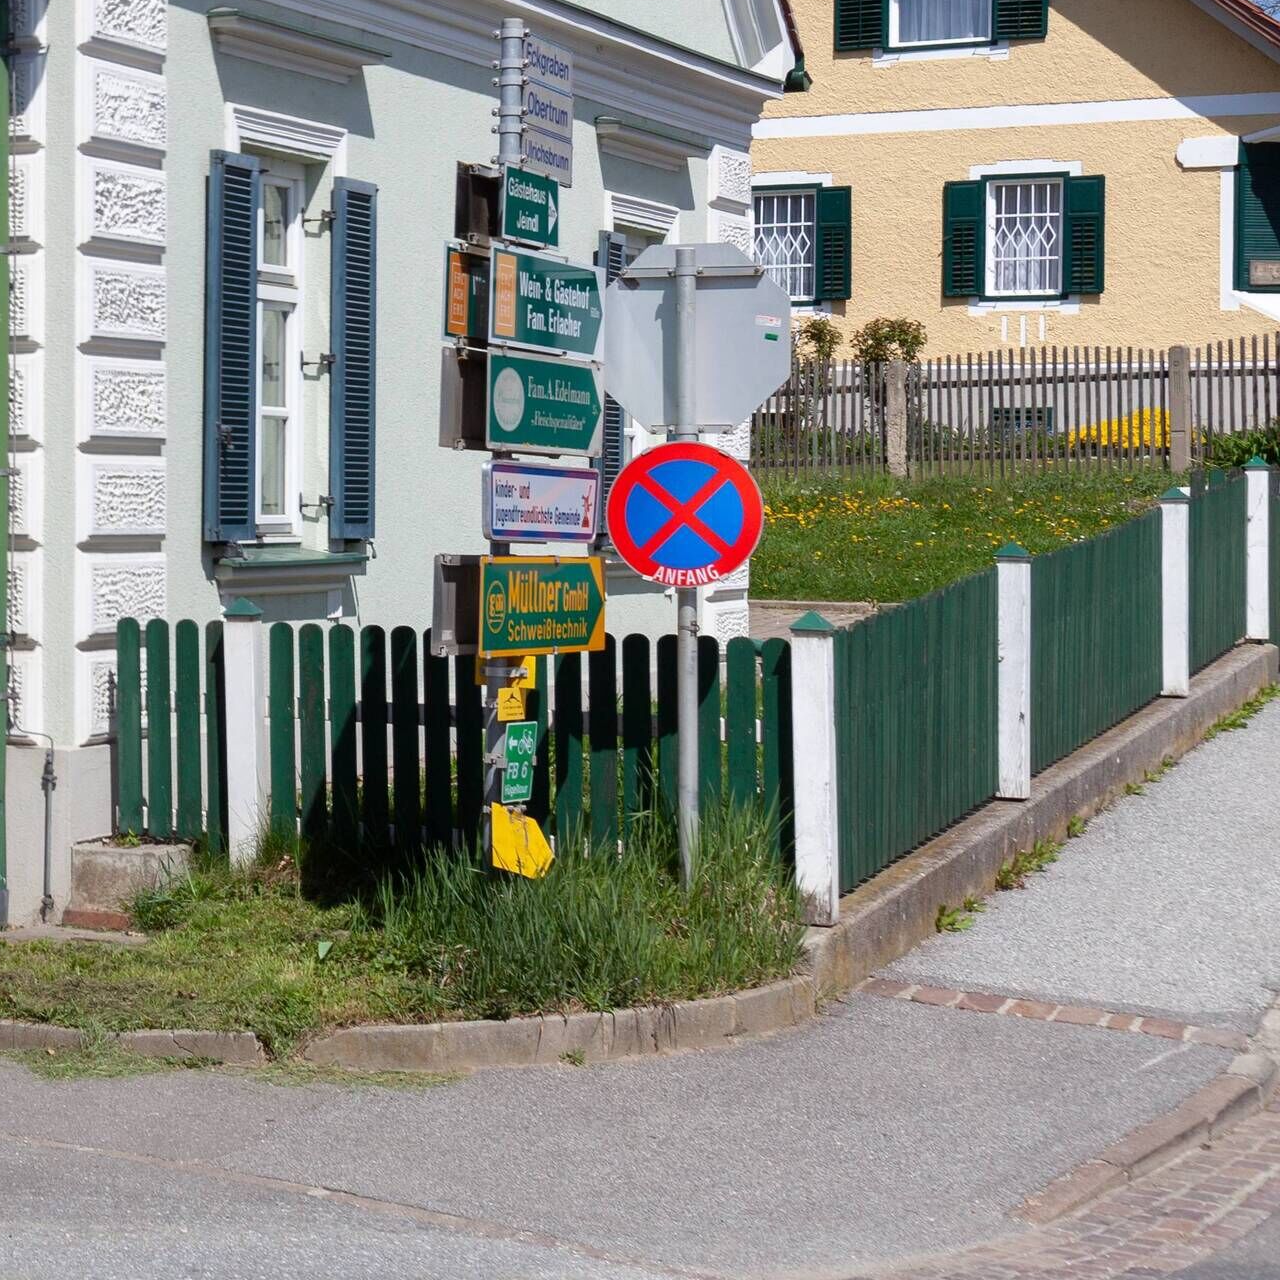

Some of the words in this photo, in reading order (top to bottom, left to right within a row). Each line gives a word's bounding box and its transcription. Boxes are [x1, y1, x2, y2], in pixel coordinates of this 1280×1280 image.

[527, 42, 569, 81] Eckgraben
[527, 91, 568, 128] Obertrum
[508, 177, 546, 205] Gästehaus
[517, 210, 539, 232] Jeindl
[519, 271, 544, 300] Wein-
[545, 277, 552, 302] &
[554, 279, 590, 310] Gästehof
[527, 303, 547, 332] Fam.
[549, 308, 582, 338] Erlacher
[495, 479, 517, 498] kinder-
[519, 481, 530, 499] und
[495, 503, 553, 527] jugendfreundlichste
[554, 506, 580, 526] Gemeinde
[653, 564, 719, 586] ANFANG
[508, 570, 561, 614] Müllner
[563, 582, 589, 612] GmbH
[508, 617, 588, 642] Schweißtechnik
[506, 762, 519, 779] FB
[521, 761, 529, 778] 6
